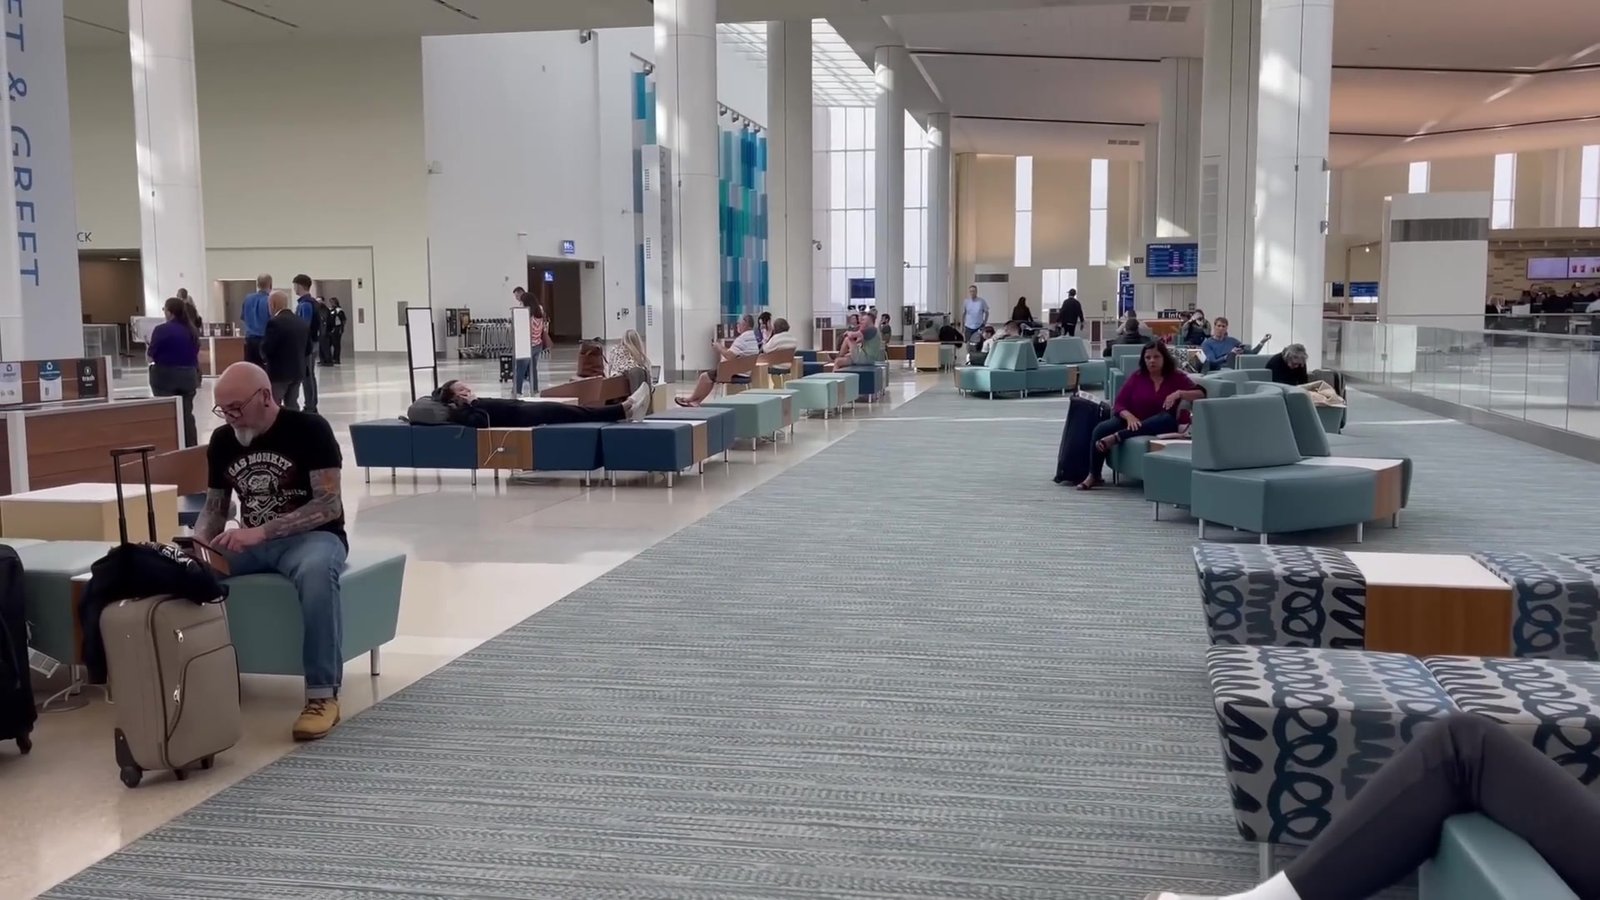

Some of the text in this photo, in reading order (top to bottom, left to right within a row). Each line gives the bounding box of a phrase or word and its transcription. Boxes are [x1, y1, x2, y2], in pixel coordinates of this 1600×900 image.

[11, 126, 39, 286] GREET
[228, 459, 247, 476] GAS
[248, 453, 292, 470] MONKEY
